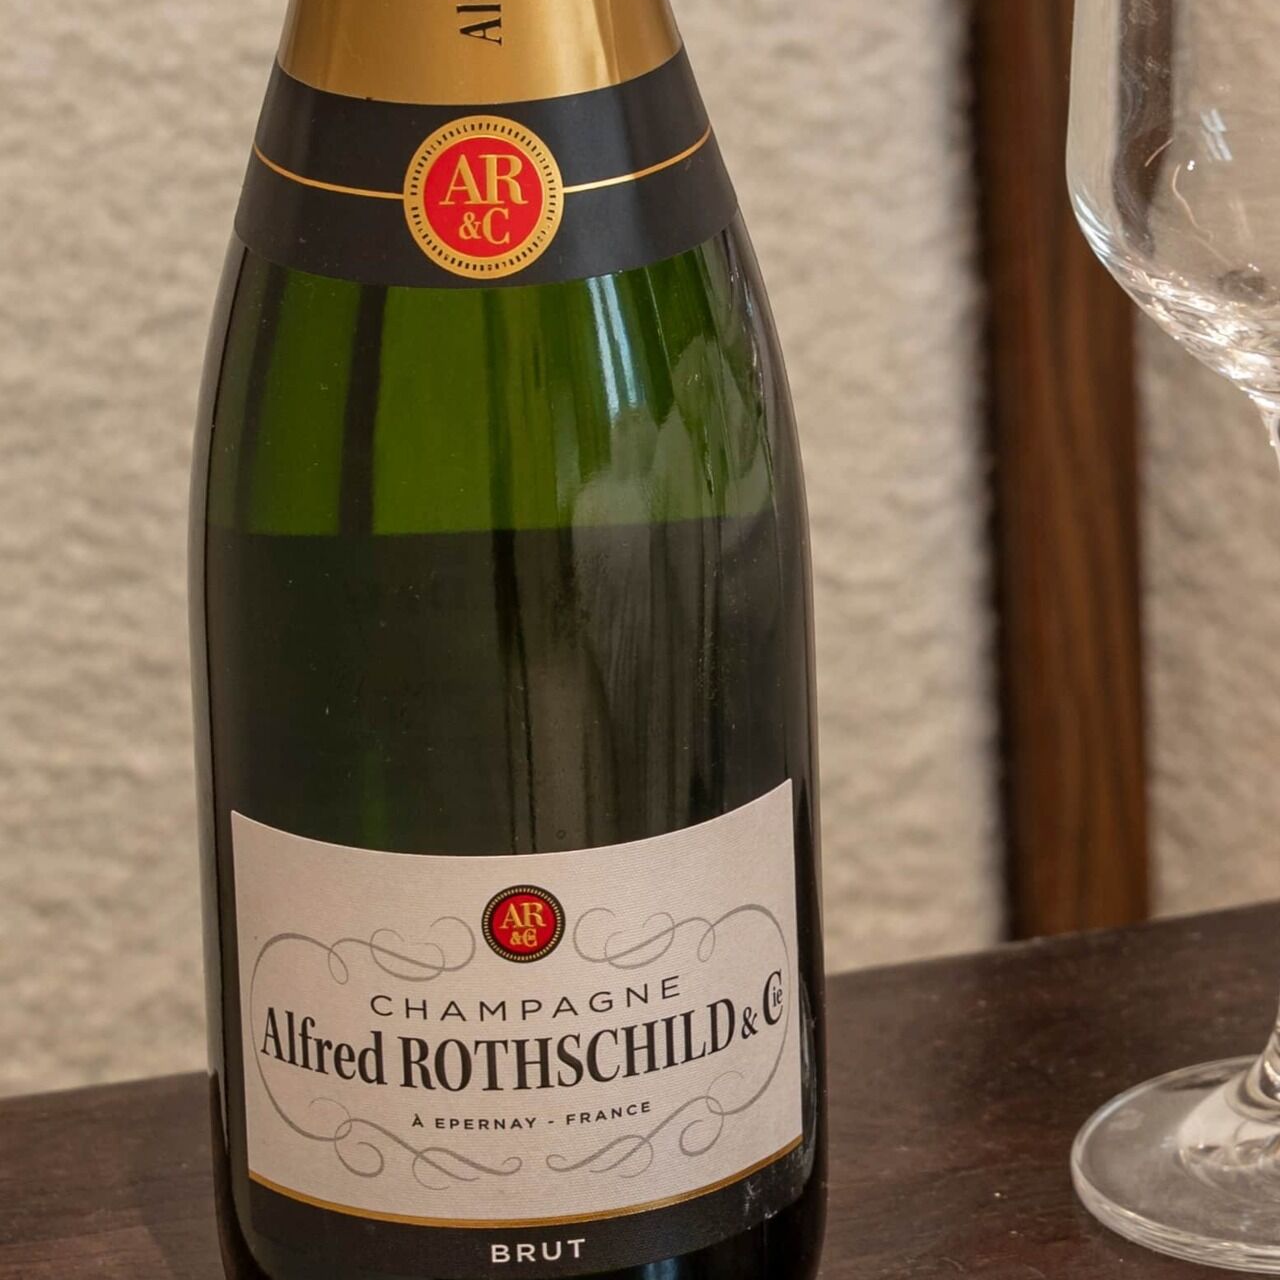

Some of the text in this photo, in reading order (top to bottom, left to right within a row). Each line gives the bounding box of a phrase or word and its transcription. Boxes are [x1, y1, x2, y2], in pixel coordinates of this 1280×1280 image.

[438, 153, 528, 206] AR
[499, 902, 547, 928] AR
[370, 975, 681, 1022] CHAMPAGNE
[260, 1007, 388, 1086] Alfred
[397, 997, 736, 1092] ROTHSCHILD
[741, 1006, 759, 1040] &
[435, 1116, 537, 1131] EPERNAY
[565, 1100, 652, 1126] FRANCE
[491, 1238, 586, 1263] BRUT
